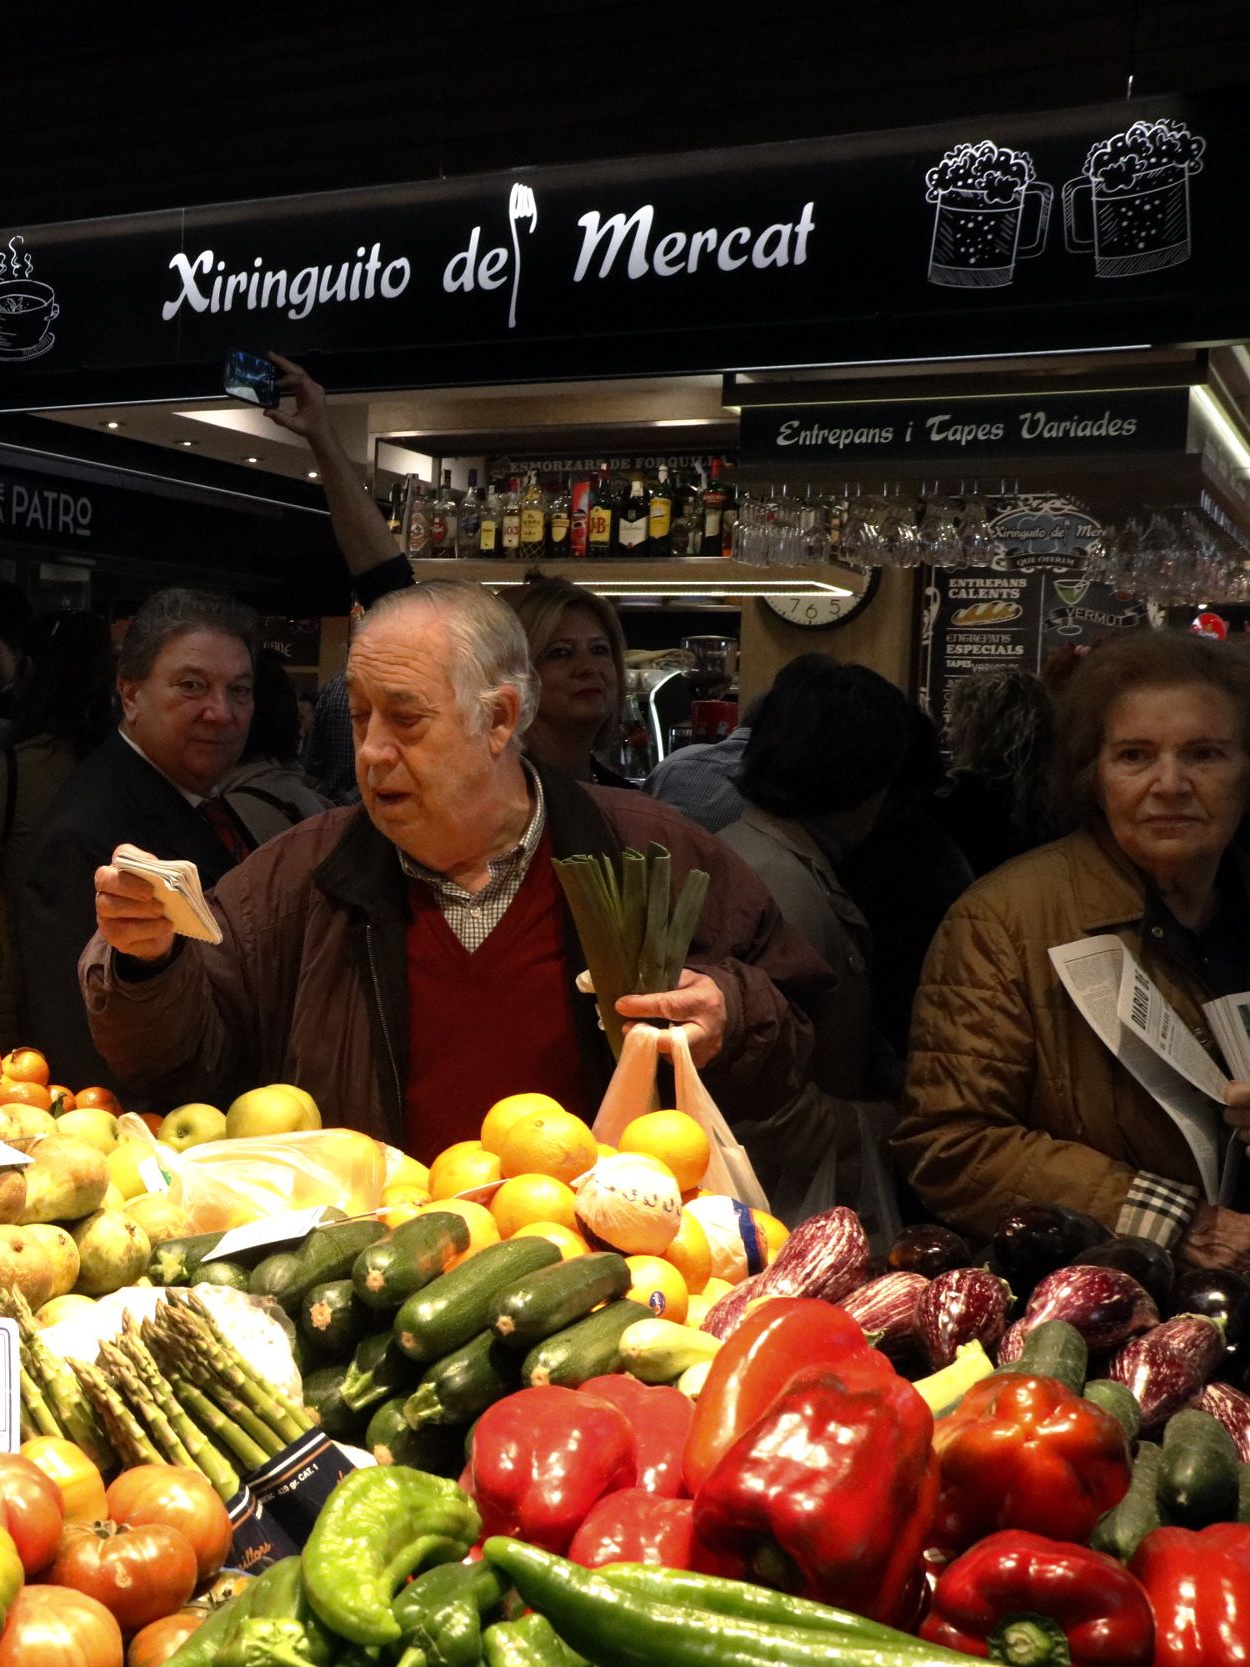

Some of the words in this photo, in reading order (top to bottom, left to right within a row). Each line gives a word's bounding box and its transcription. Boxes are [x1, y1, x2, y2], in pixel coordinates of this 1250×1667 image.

[162, 243, 411, 320] Xiringuito
[573, 201, 815, 282] Mercat
[776, 420, 894, 449] Entrepans
[905, 421, 914, 442] i
[925, 414, 1004, 445] Tapes
[1019, 411, 1138, 440] Variades
[611, 457, 631, 471] DE
[948, 578, 1028, 588] ENTREPANS
[948, 588, 1021, 599] CALENTS
[791, 598, 800, 613] 7
[806, 603, 817, 619] 6
[830, 599, 841, 615] 5
[1066, 607, 1126, 626] VERMUT
[945, 645, 1025, 655] ESPECIALS
[1131, 986, 1149, 1030] DIARIO
